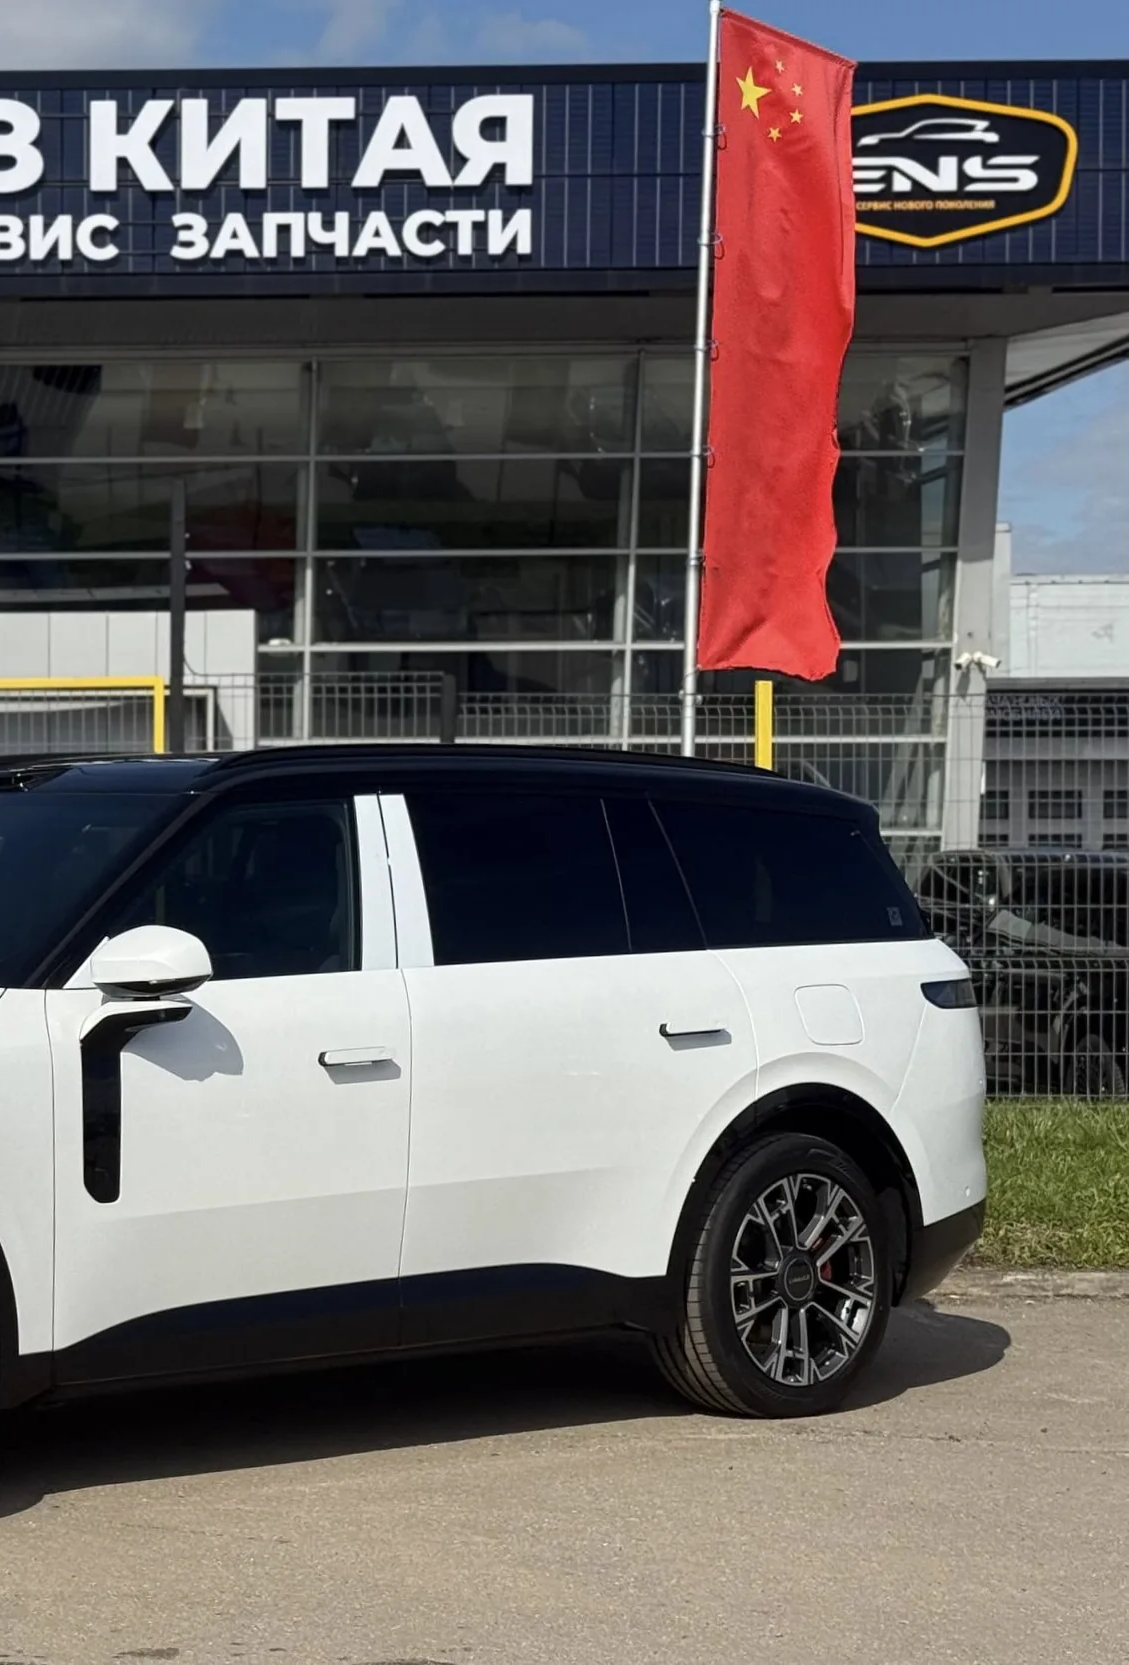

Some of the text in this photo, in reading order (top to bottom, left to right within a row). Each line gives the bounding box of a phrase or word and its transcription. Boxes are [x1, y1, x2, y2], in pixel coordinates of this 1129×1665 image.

[90, 94, 534, 191] КИТАЯ
[856, 200, 996, 211] СЕРВИС НОВОГО ПОКОЛЕНИЯ
[171, 208, 533, 260] ЗАПЧАСТИ
